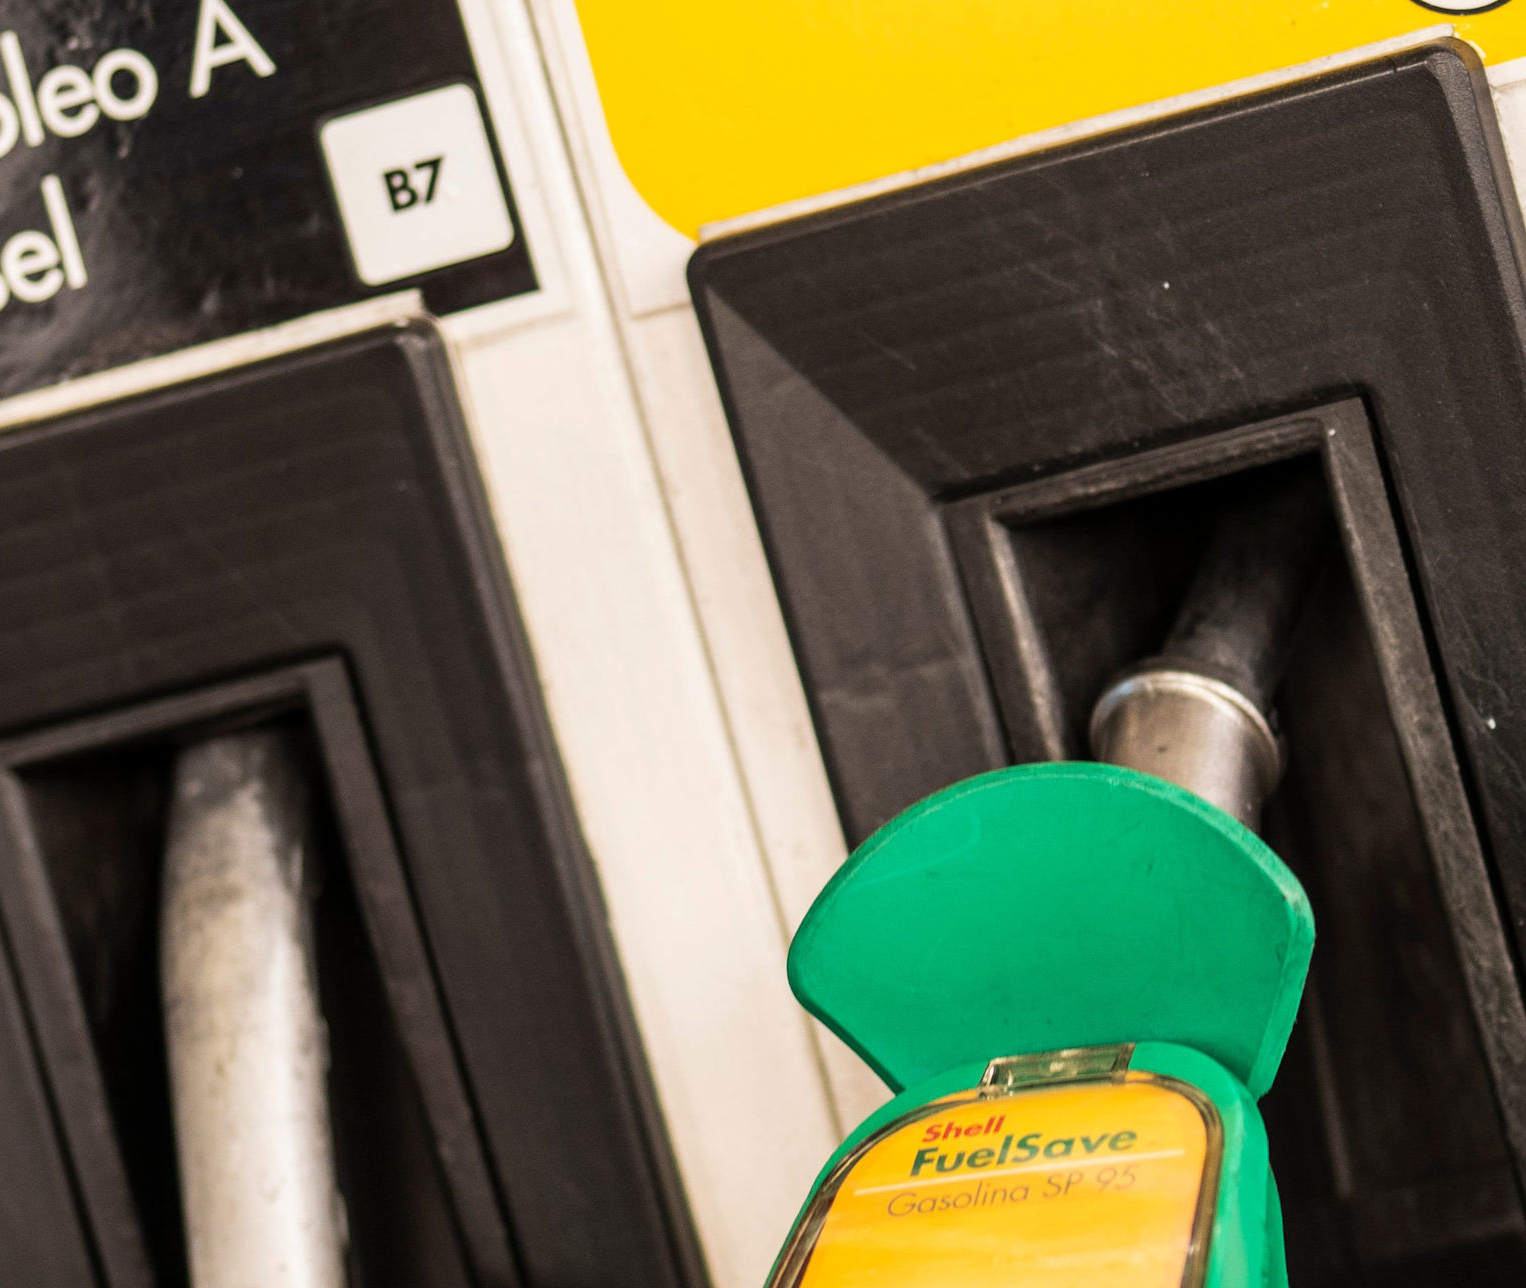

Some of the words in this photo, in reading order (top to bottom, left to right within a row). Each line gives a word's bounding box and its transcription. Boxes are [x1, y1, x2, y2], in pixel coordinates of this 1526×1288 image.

[190, 0, 276, 98] A
[382, 157, 446, 214] B7
[910, 1129, 1137, 1177] FuelSave
[922, 1115, 1006, 1143] Shell
[887, 1181, 1029, 1218] Gasolina
[1042, 1171, 1084, 1198] SP
[1096, 1166, 1138, 1192] 95
